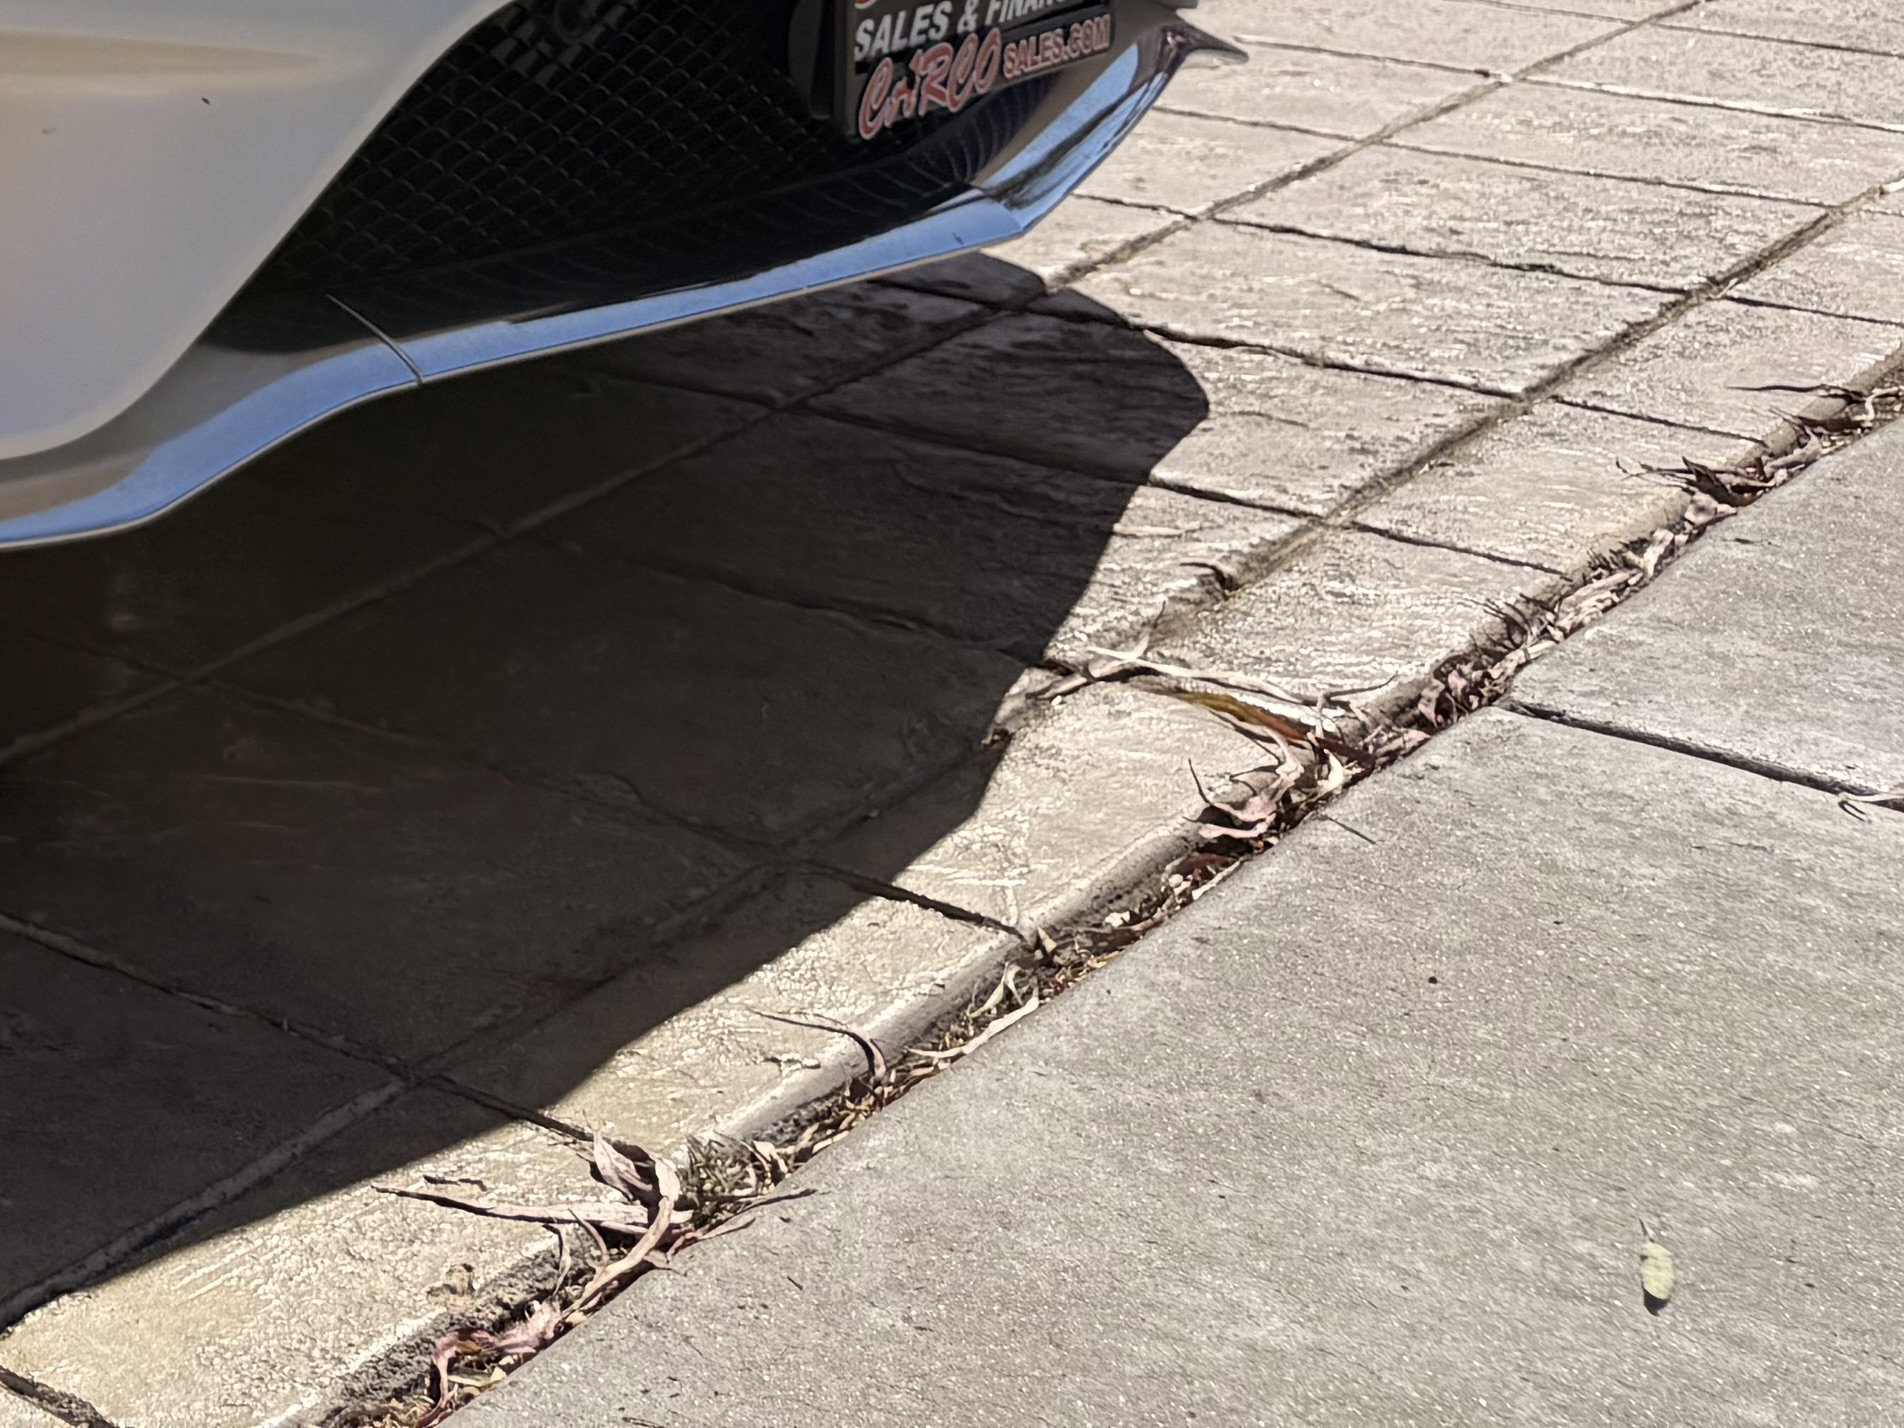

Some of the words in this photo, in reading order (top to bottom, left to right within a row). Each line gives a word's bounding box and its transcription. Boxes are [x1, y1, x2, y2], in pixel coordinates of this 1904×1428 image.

[854, 0, 953, 61] SALES
[858, 27, 1002, 141] CARCO
[1002, 13, 1112, 80] SALES.COM
